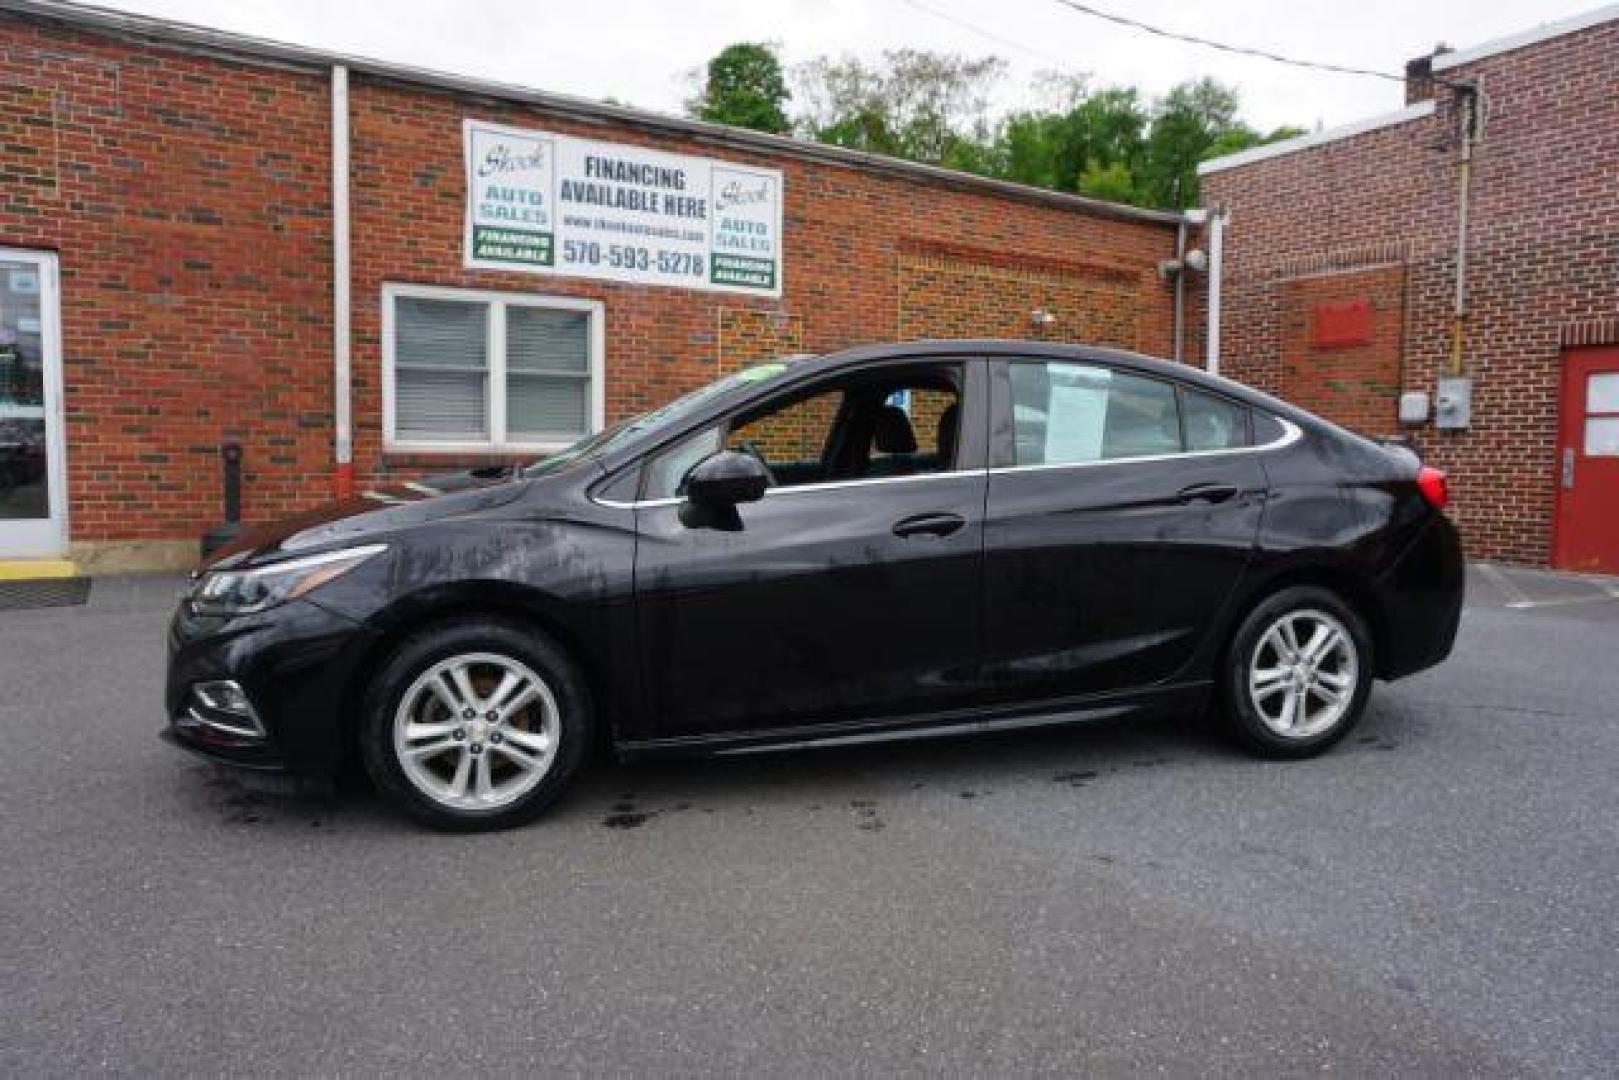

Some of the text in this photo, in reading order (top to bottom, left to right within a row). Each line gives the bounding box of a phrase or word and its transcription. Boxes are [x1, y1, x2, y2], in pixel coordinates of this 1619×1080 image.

[586, 156, 686, 190] FINANCING
[486, 186, 542, 205] AUTO
[561, 179, 707, 219] AVAILABLE HERE
[480, 202, 547, 223] SALES
[720, 217, 767, 235] AUTO
[715, 232, 769, 251] SALES
[563, 239, 704, 276] 570-593-5278
